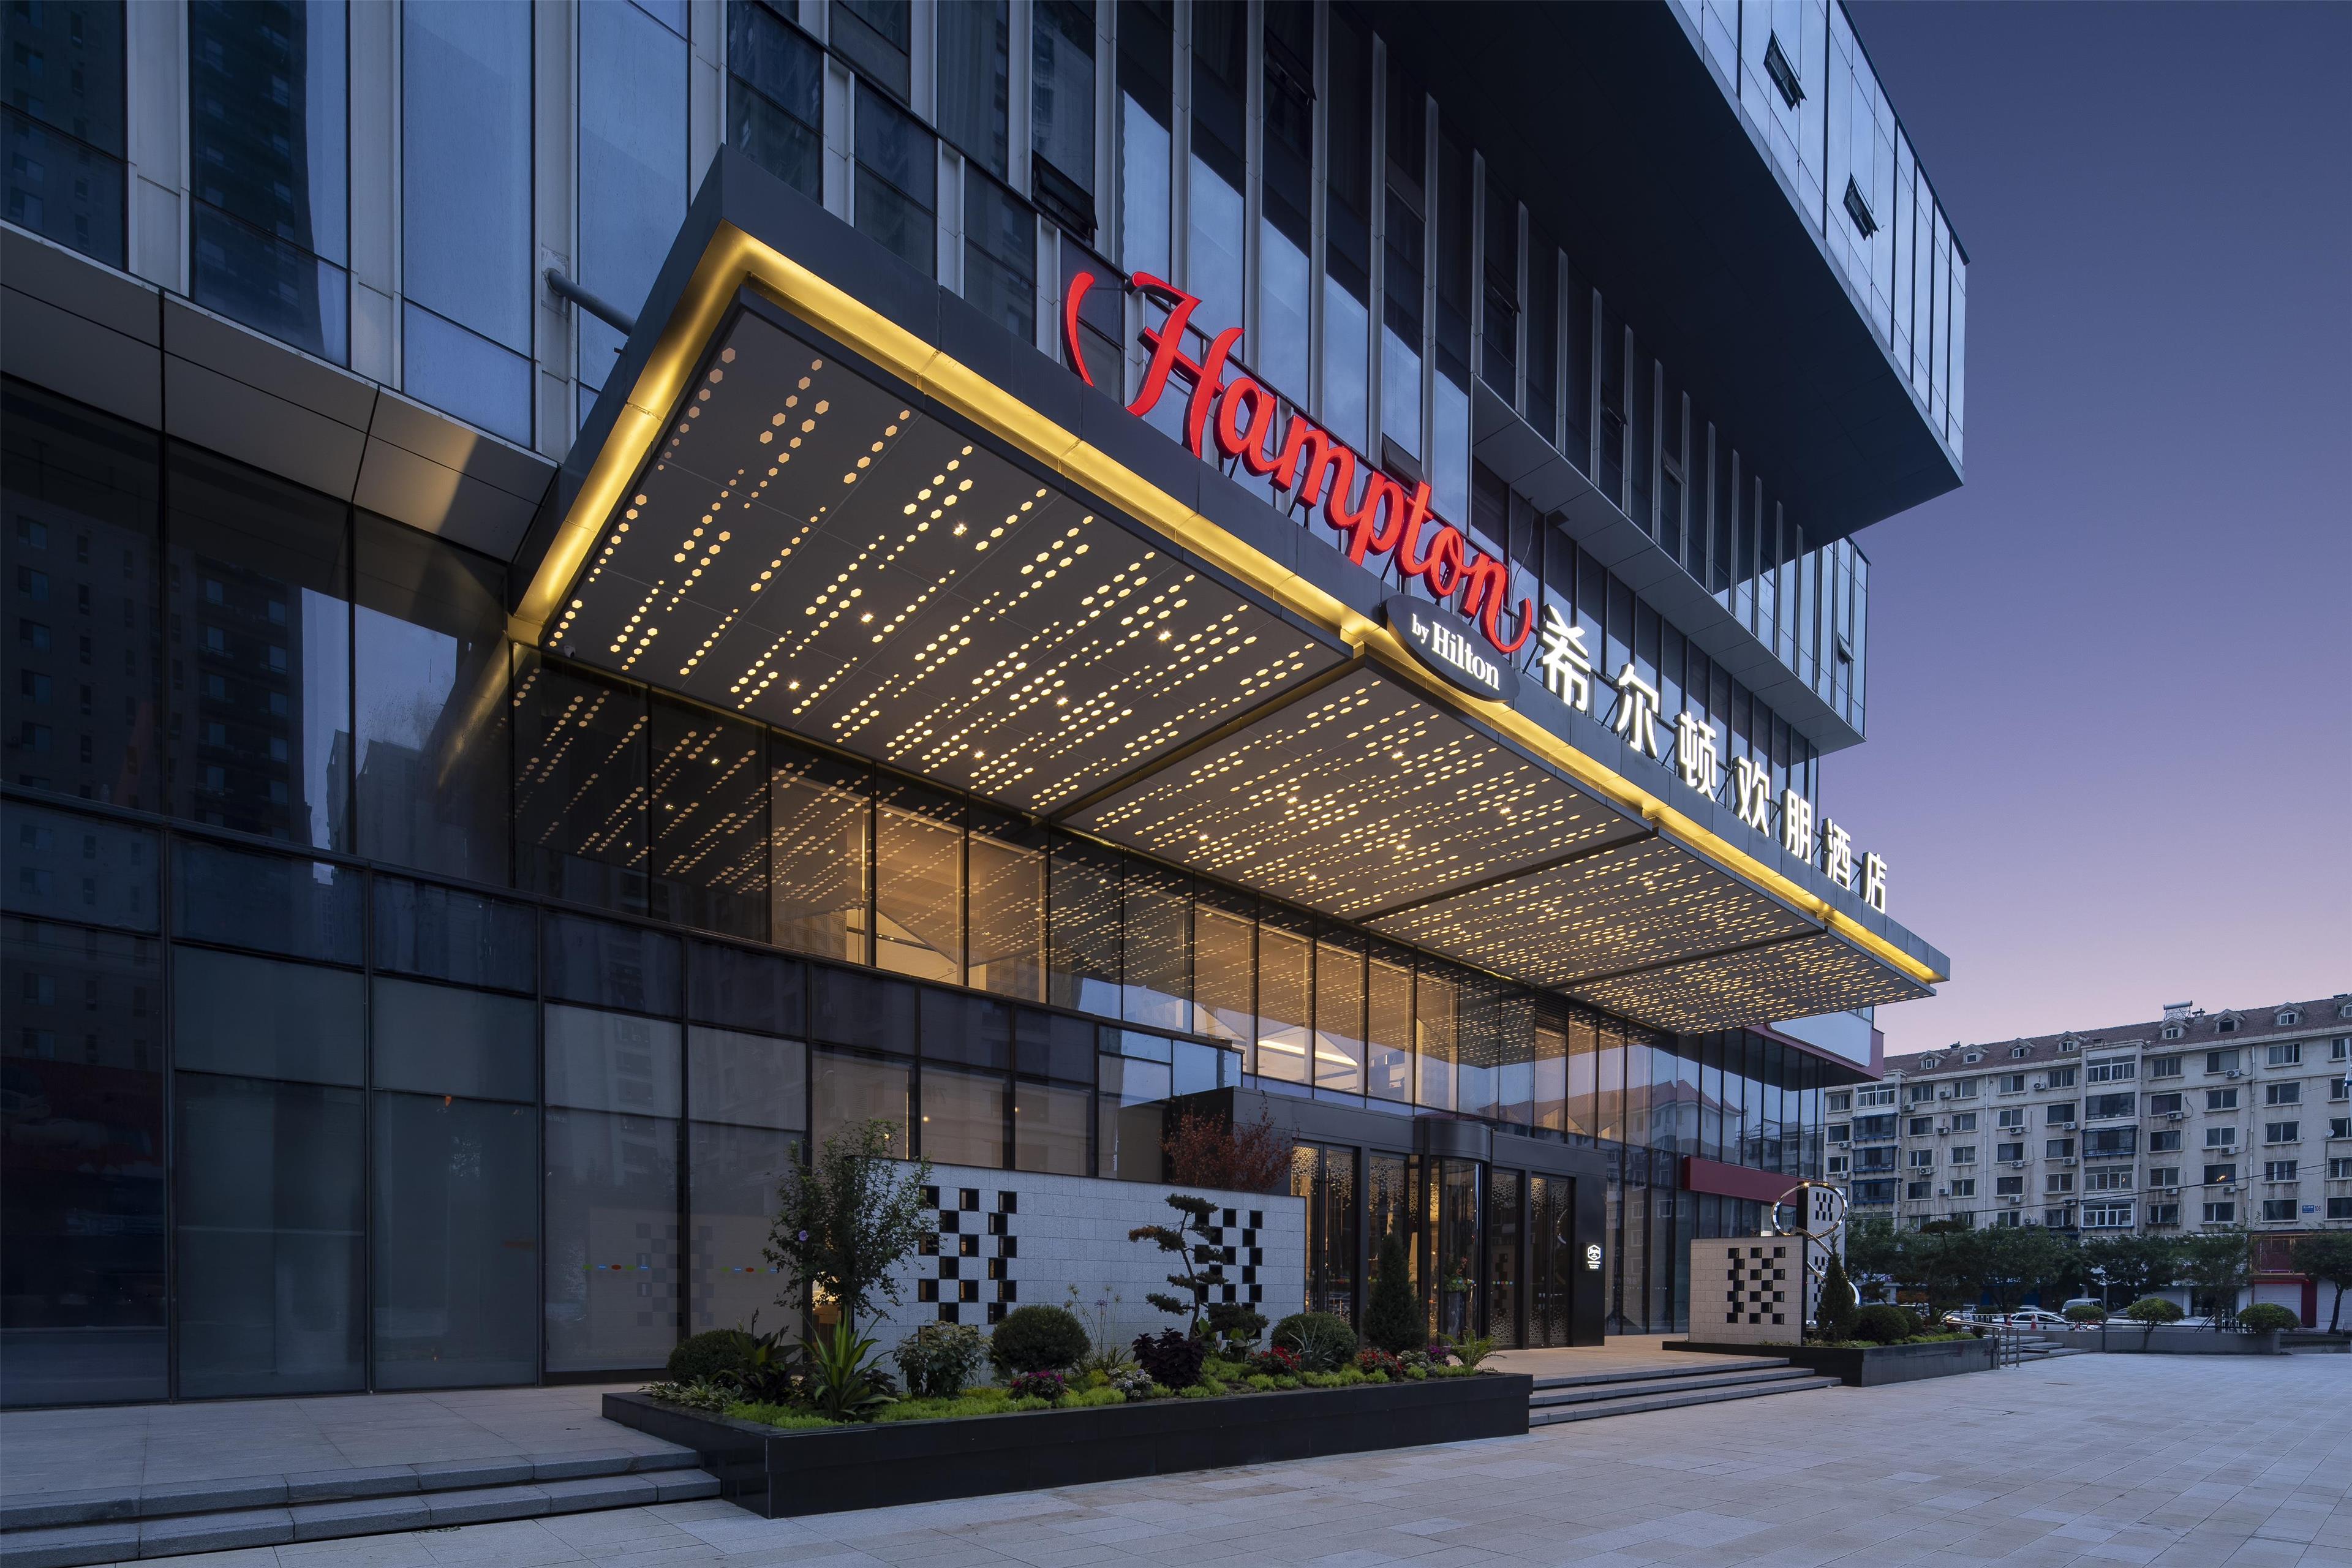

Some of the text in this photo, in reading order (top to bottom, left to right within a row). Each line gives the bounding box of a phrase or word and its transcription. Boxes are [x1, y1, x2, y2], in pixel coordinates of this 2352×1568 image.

[1061, 271, 1532, 653] Hampton
[1412, 613, 1500, 691] by Hilton
[1540, 605, 1888, 914] 希尔顿欢朋酒店
